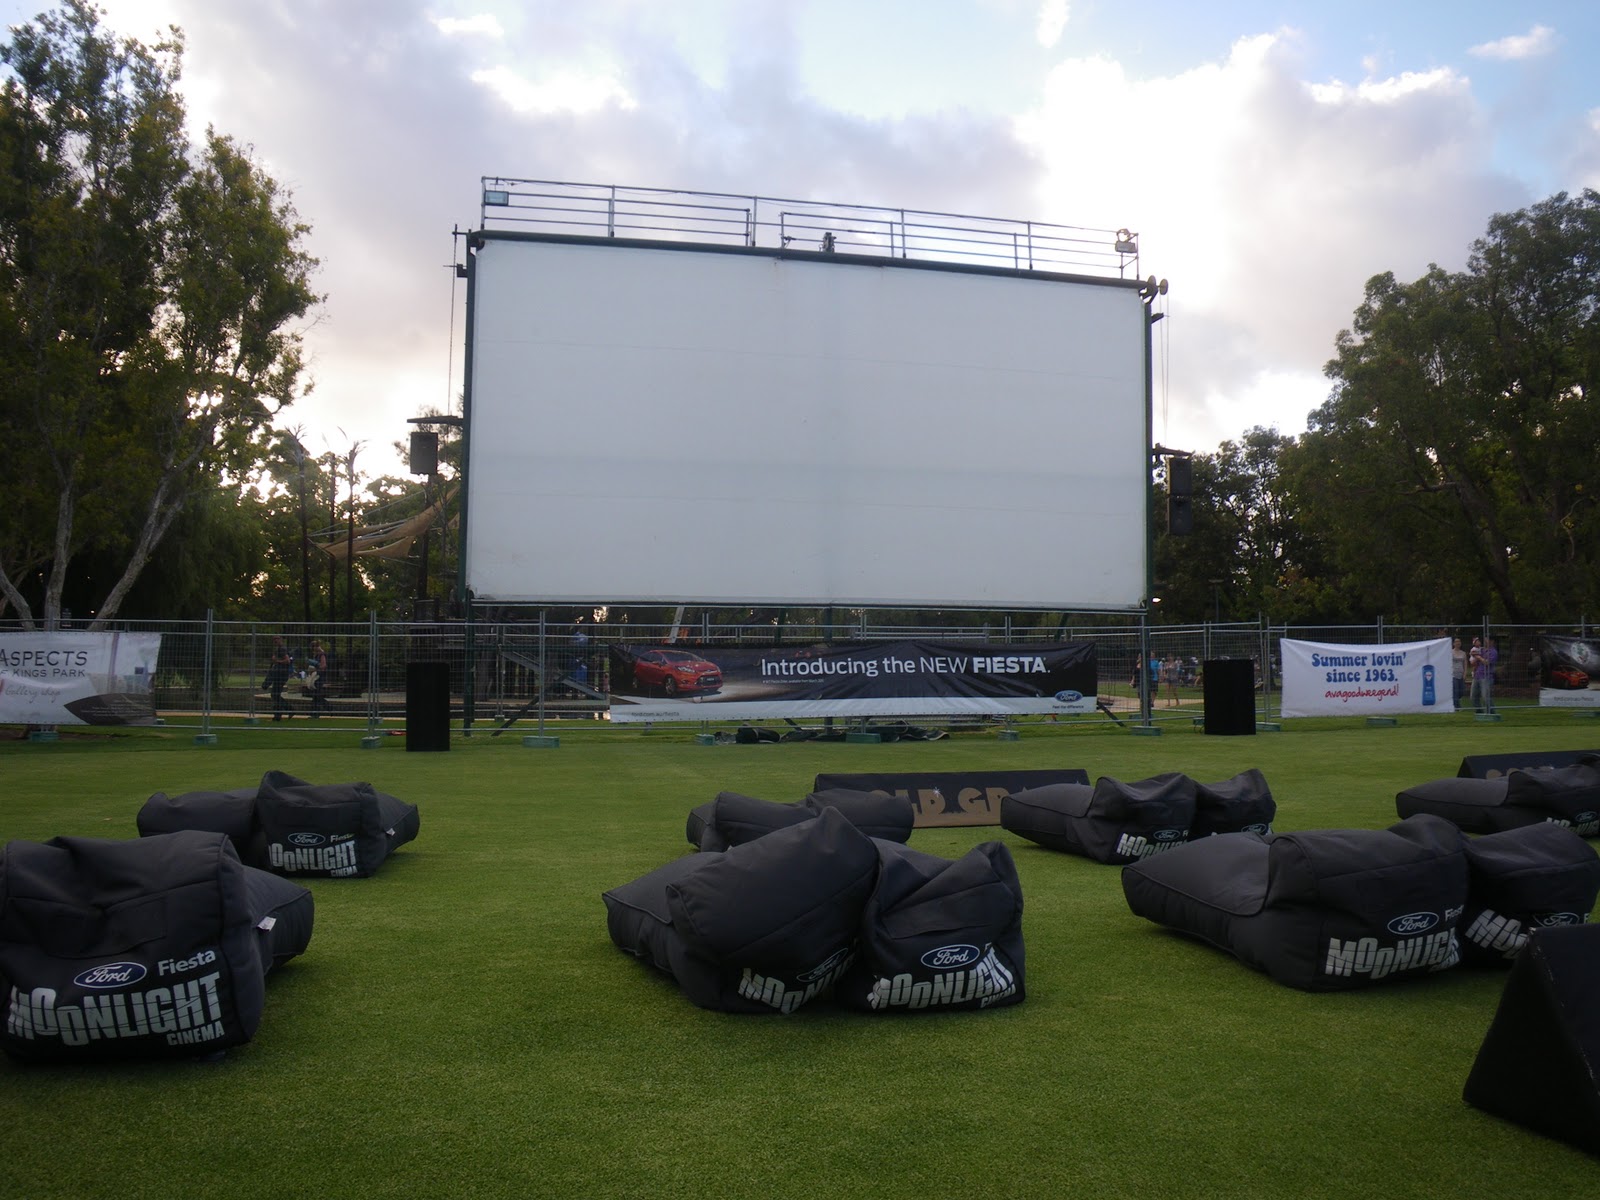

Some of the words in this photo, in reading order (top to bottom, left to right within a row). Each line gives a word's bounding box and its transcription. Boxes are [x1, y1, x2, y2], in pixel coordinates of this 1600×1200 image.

[761, 657, 879, 677] Introducing
[882, 656, 916, 674] the
[920, 656, 968, 674] NEW
[1311, 653, 1368, 667] Summer
[1371, 652, 1407, 667] lovin'
[12, 668, 48, 678] KINGS
[52, 668, 86, 678] PARK
[1326, 669, 1361, 683] since
[1365, 668, 1399, 682] 1963.
[1324, 683, 1400, 703] avagoodweegend!
[268, 840, 357, 872] OONLIGHT
[330, 865, 359, 877] CINEMA
[158, 950, 216, 977] Fiesta
[7, 971, 223, 1047] MOONLIGHT
[166, 1021, 226, 1046] CINEMA
